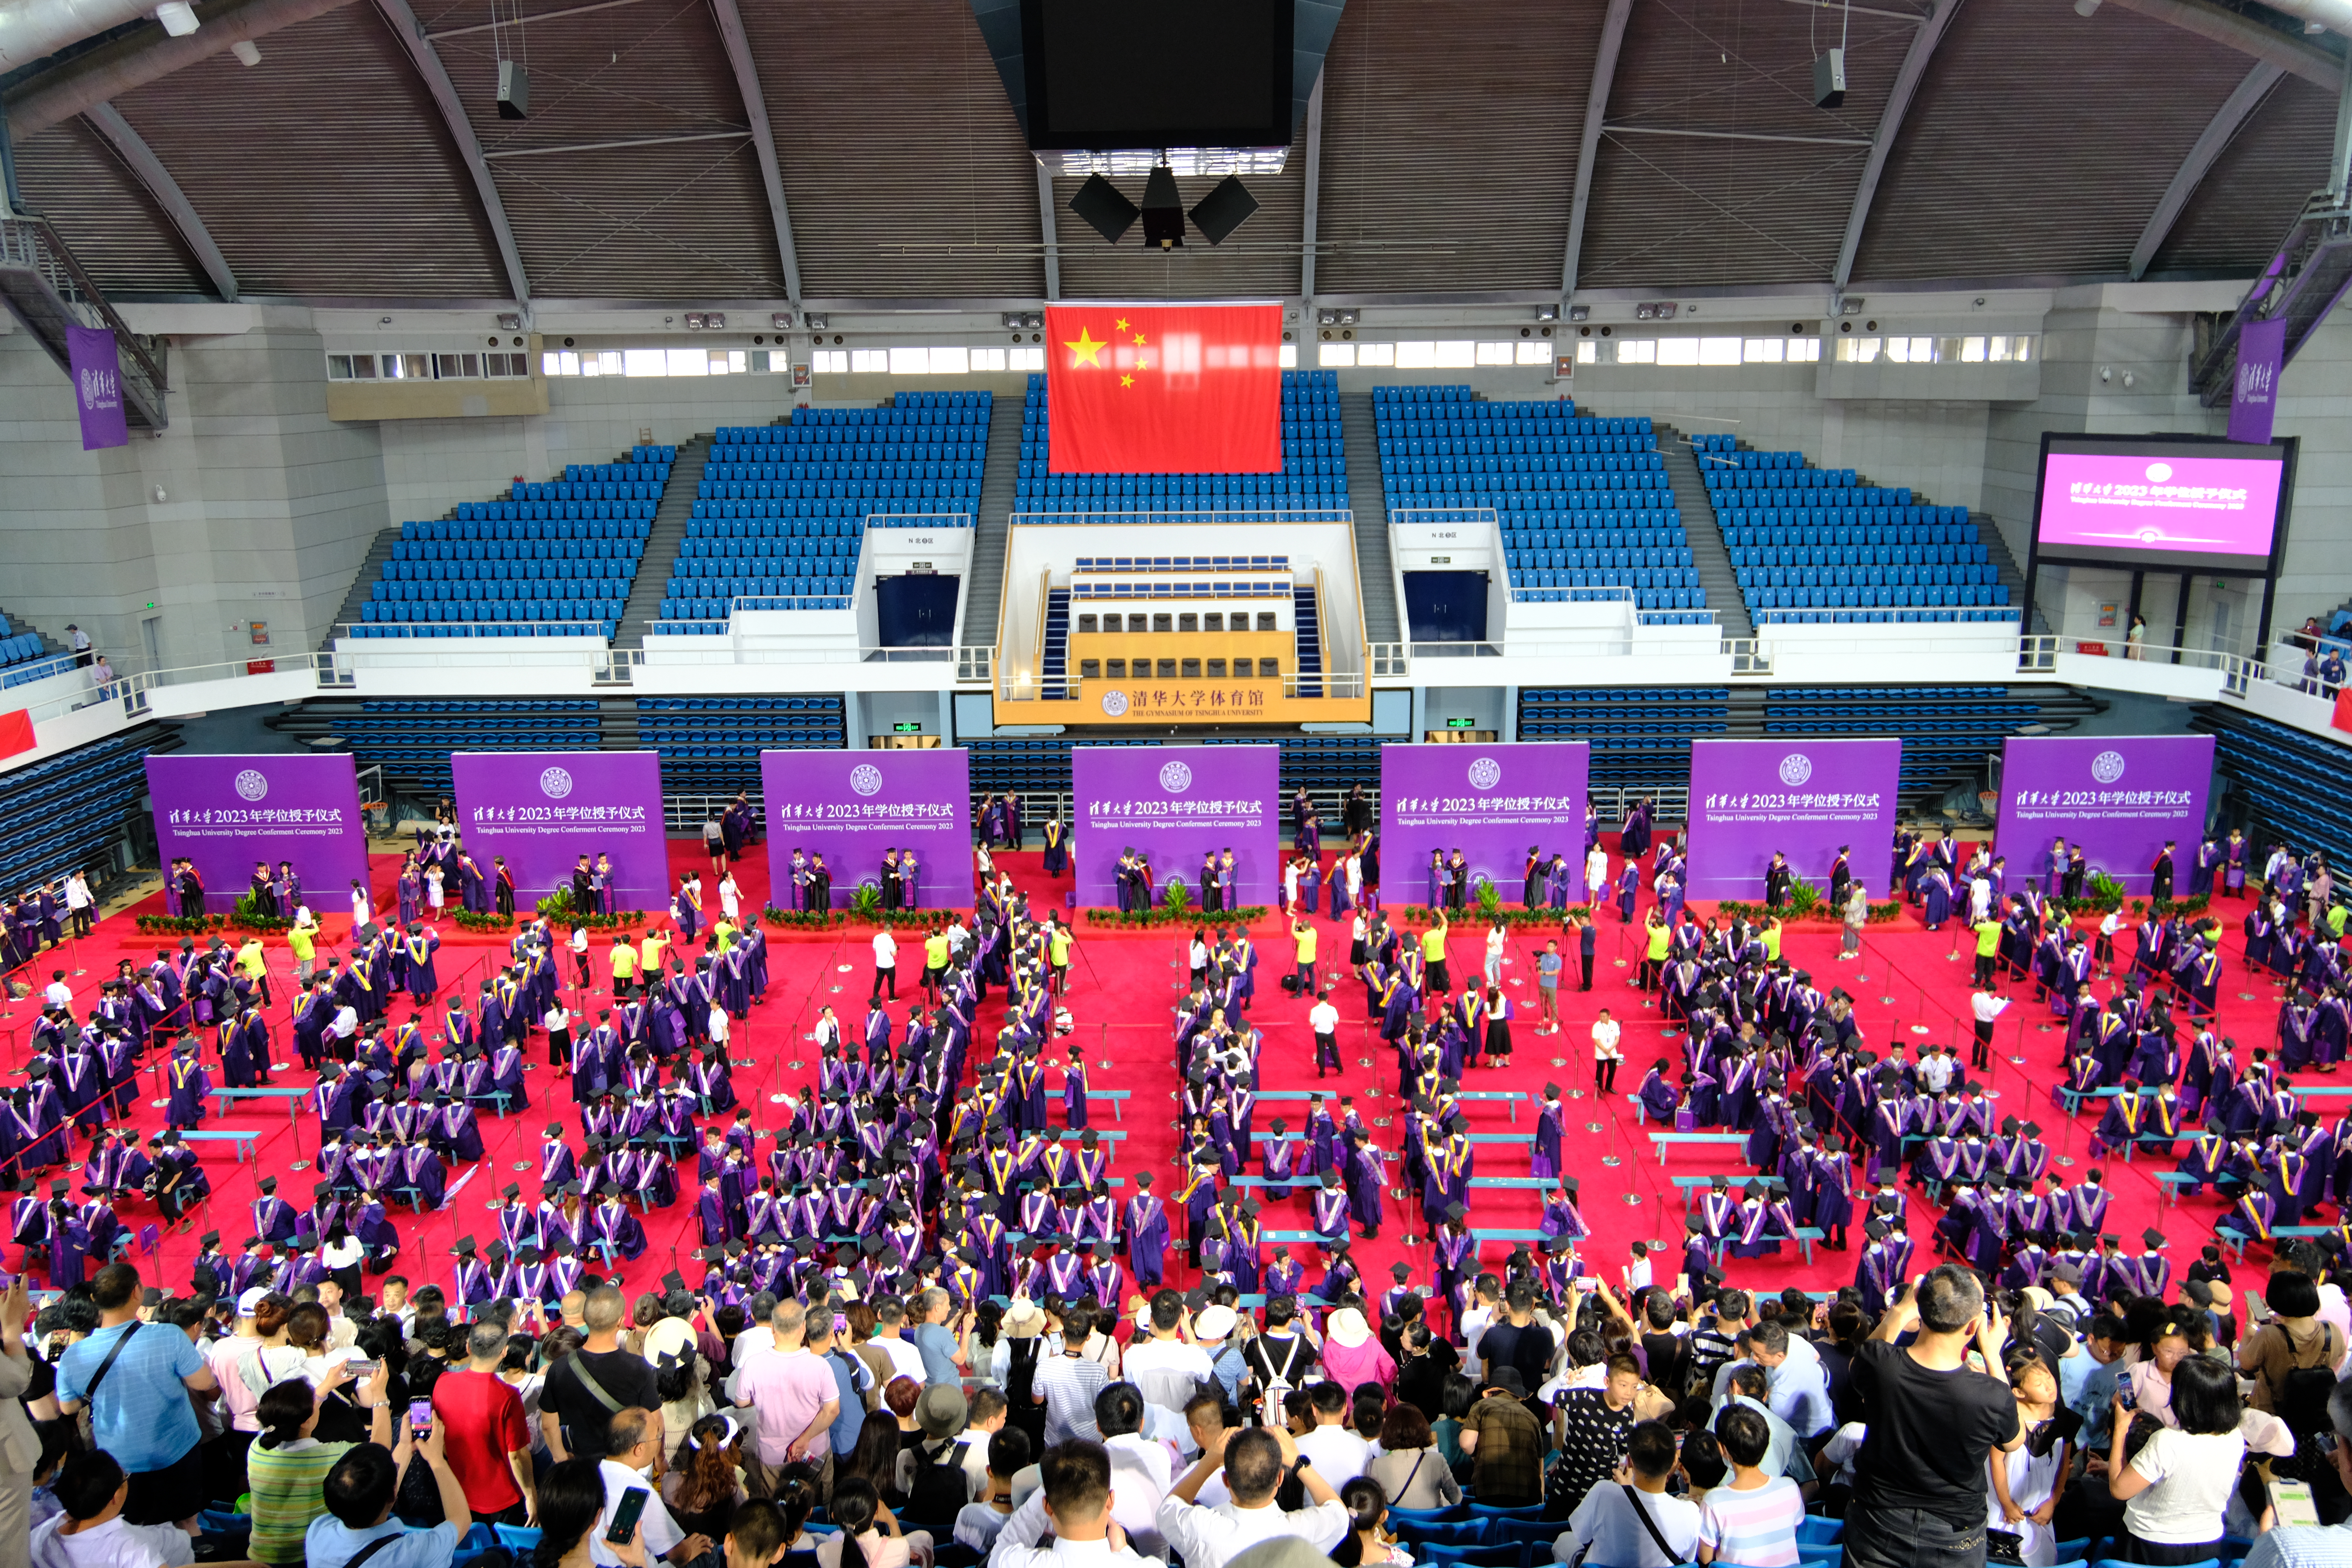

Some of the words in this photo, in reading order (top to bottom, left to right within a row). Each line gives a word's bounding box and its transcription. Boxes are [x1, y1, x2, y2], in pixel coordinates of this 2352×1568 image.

[1132, 689, 1264, 707] 清华大学体育馆
[1706, 814, 1733, 823] Tsinghua
[1735, 814, 1767, 822] University
[1769, 814, 1791, 822] Degree
[2016, 811, 2044, 820] Tsinghua
[2045, 811, 2077, 819] University
[2078, 811, 2101, 819] Degree
[2139, 810, 2171, 819] Ceremony
[1091, 821, 1118, 829] Tsinghua
[1153, 821, 1175, 829] Degree
[1398, 818, 1425, 826] Tsinghua
[1426, 818, 1458, 826] University
[476, 827, 504, 835] Tsinghua
[505, 826, 536, 835] University
[813, 824, 844, 832] University
